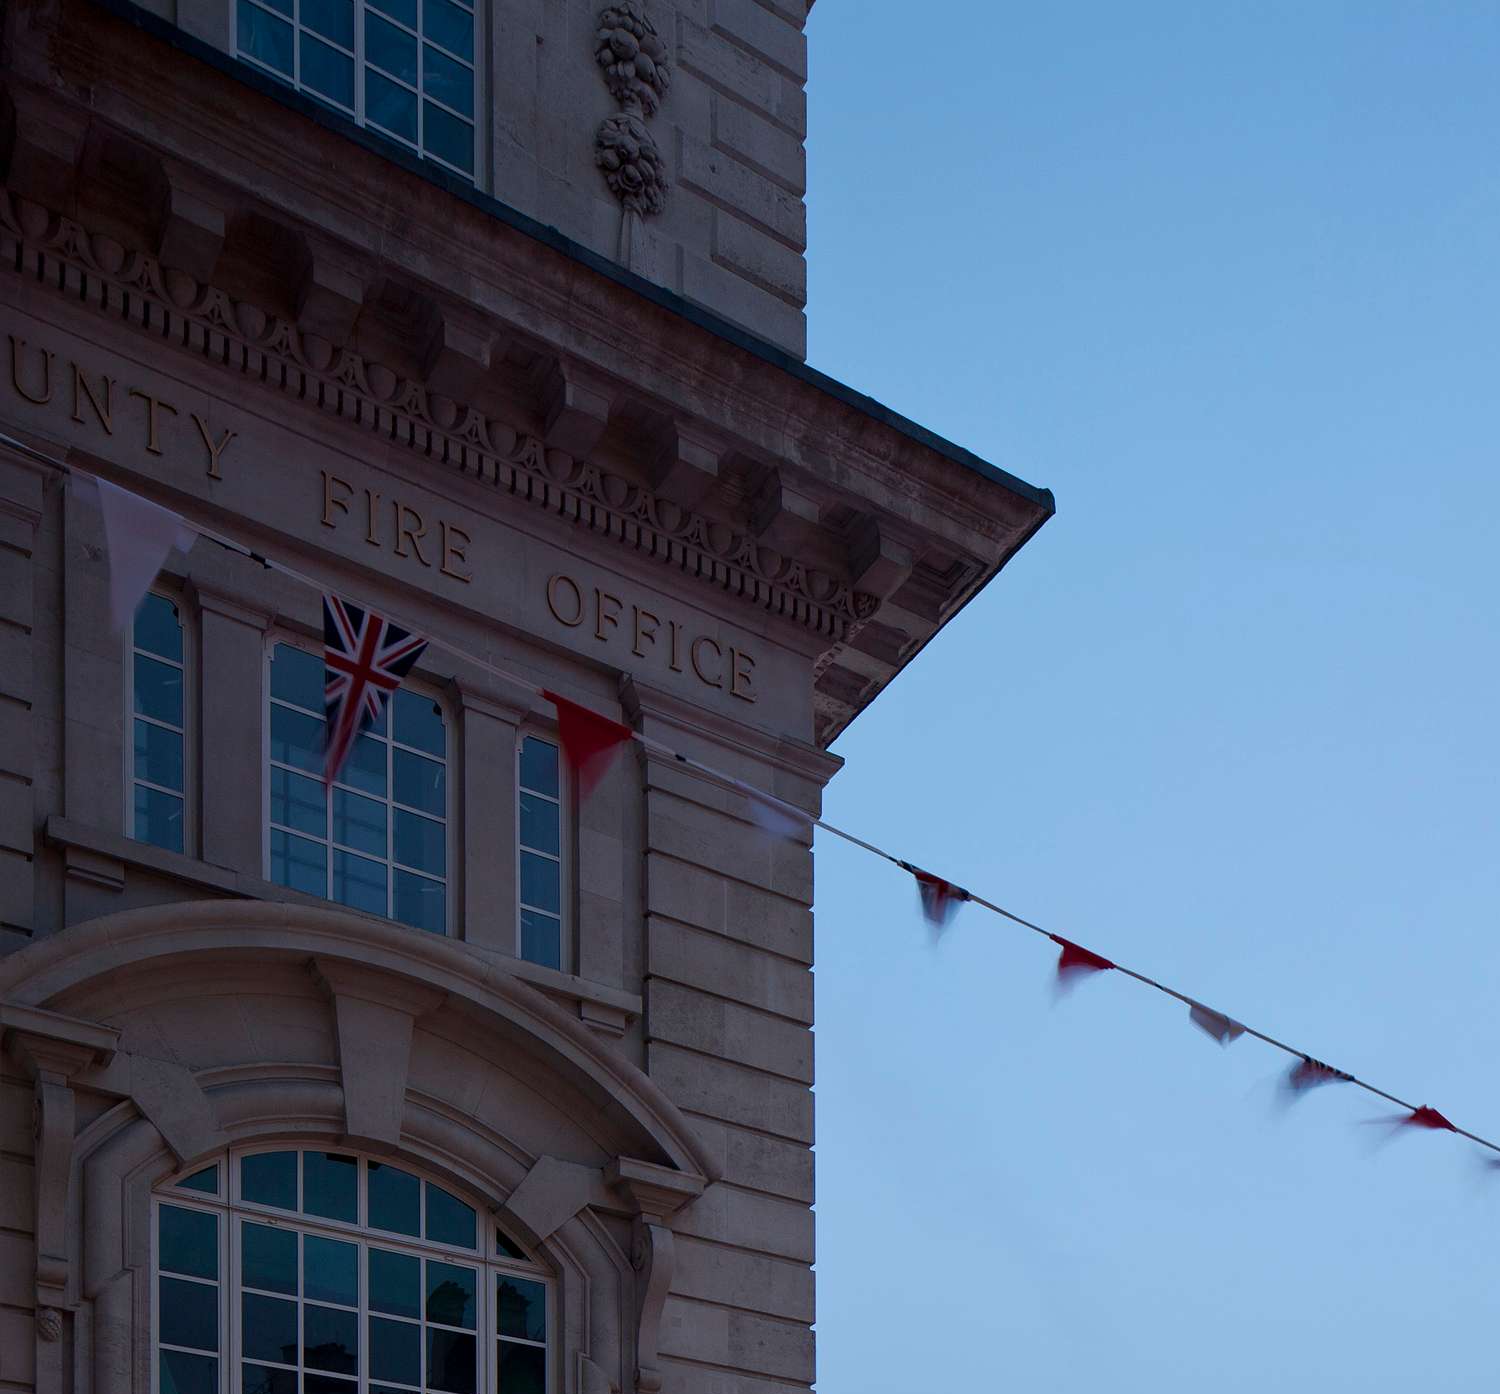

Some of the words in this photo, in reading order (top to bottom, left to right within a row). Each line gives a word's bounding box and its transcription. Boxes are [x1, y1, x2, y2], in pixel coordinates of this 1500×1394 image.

[8, 334, 237, 480] UNTY
[319, 469, 474, 584] FIRE
[545, 574, 758, 703] OFFICE
